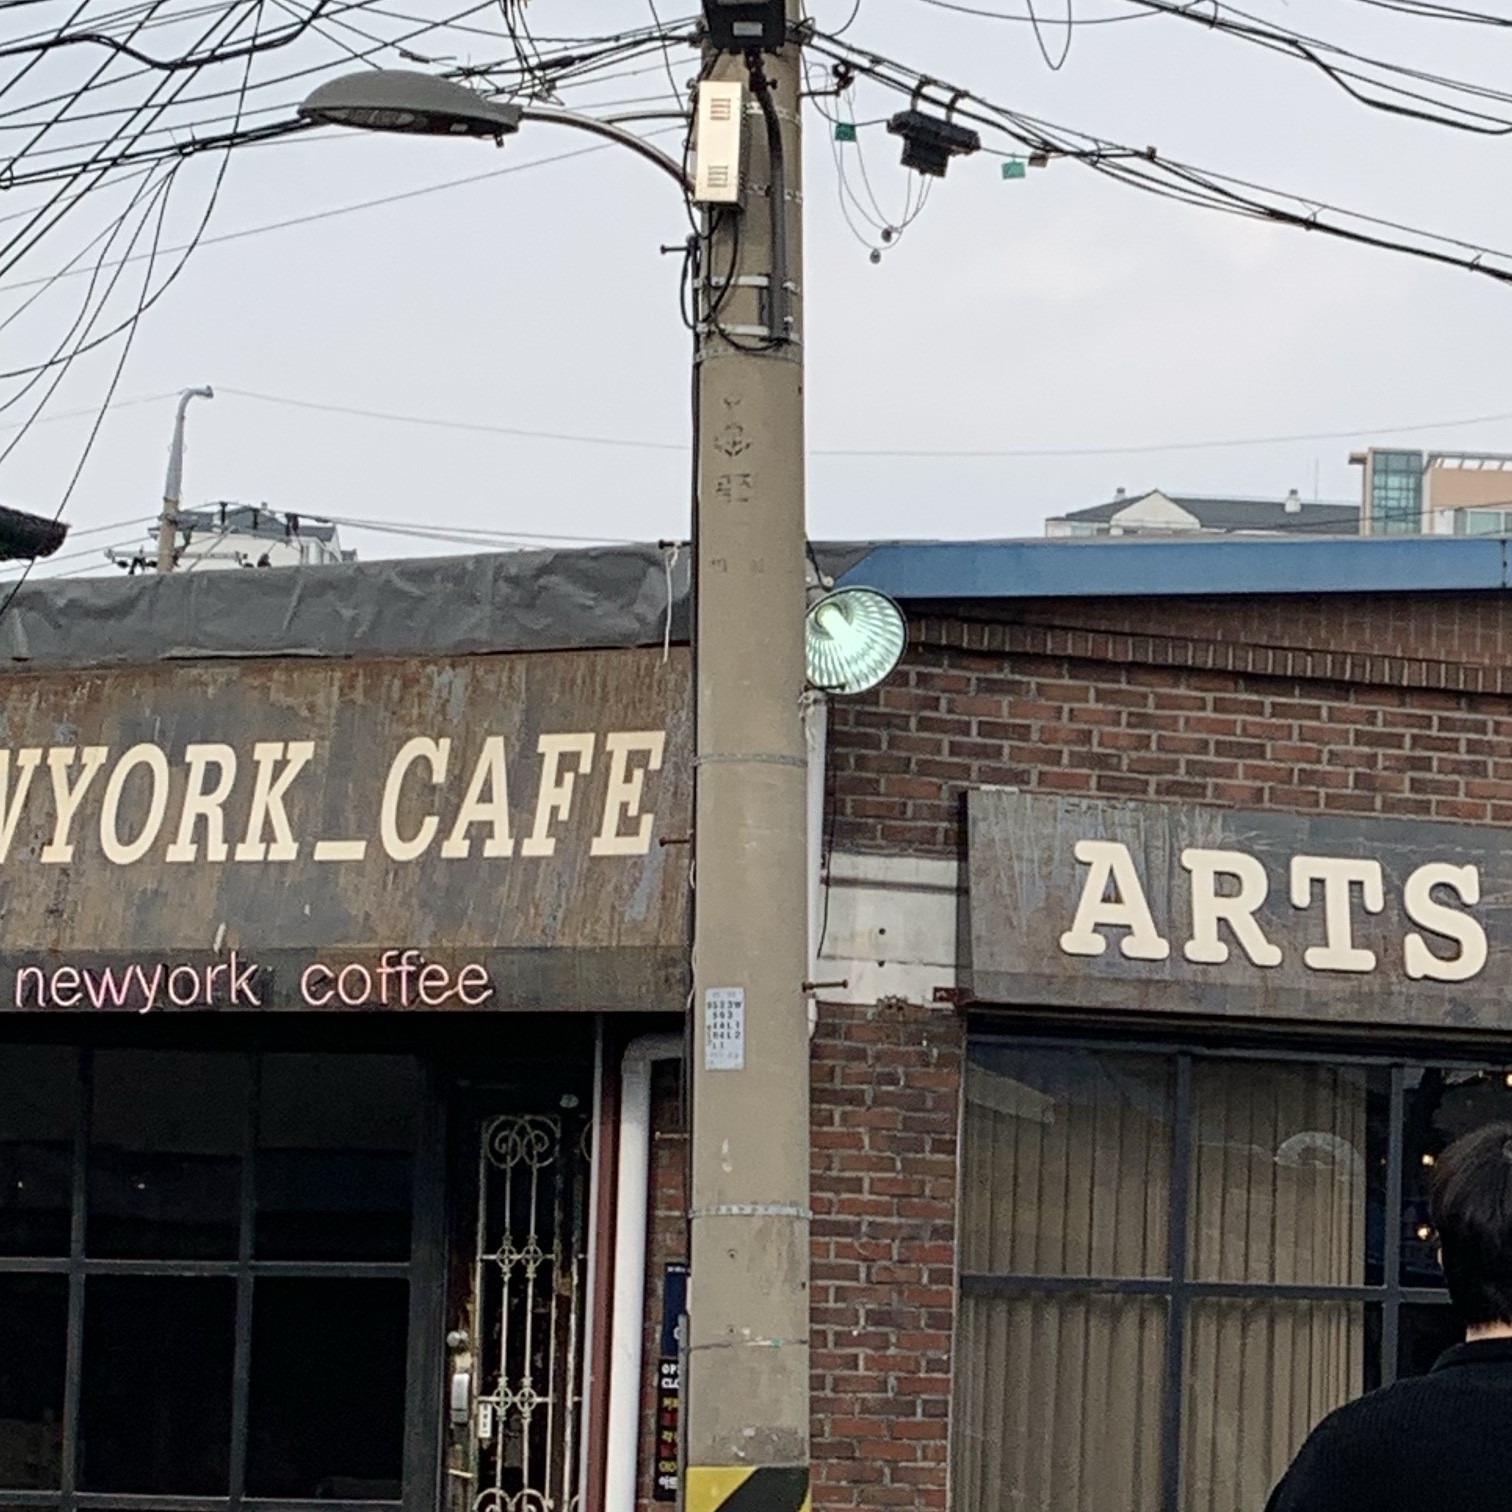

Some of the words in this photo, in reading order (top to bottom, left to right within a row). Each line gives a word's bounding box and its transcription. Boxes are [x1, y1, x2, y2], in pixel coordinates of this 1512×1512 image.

[1059, 838, 1490, 984] ARTS
[14, 949, 262, 1014] newyork
[300, 949, 496, 1006] coffee
